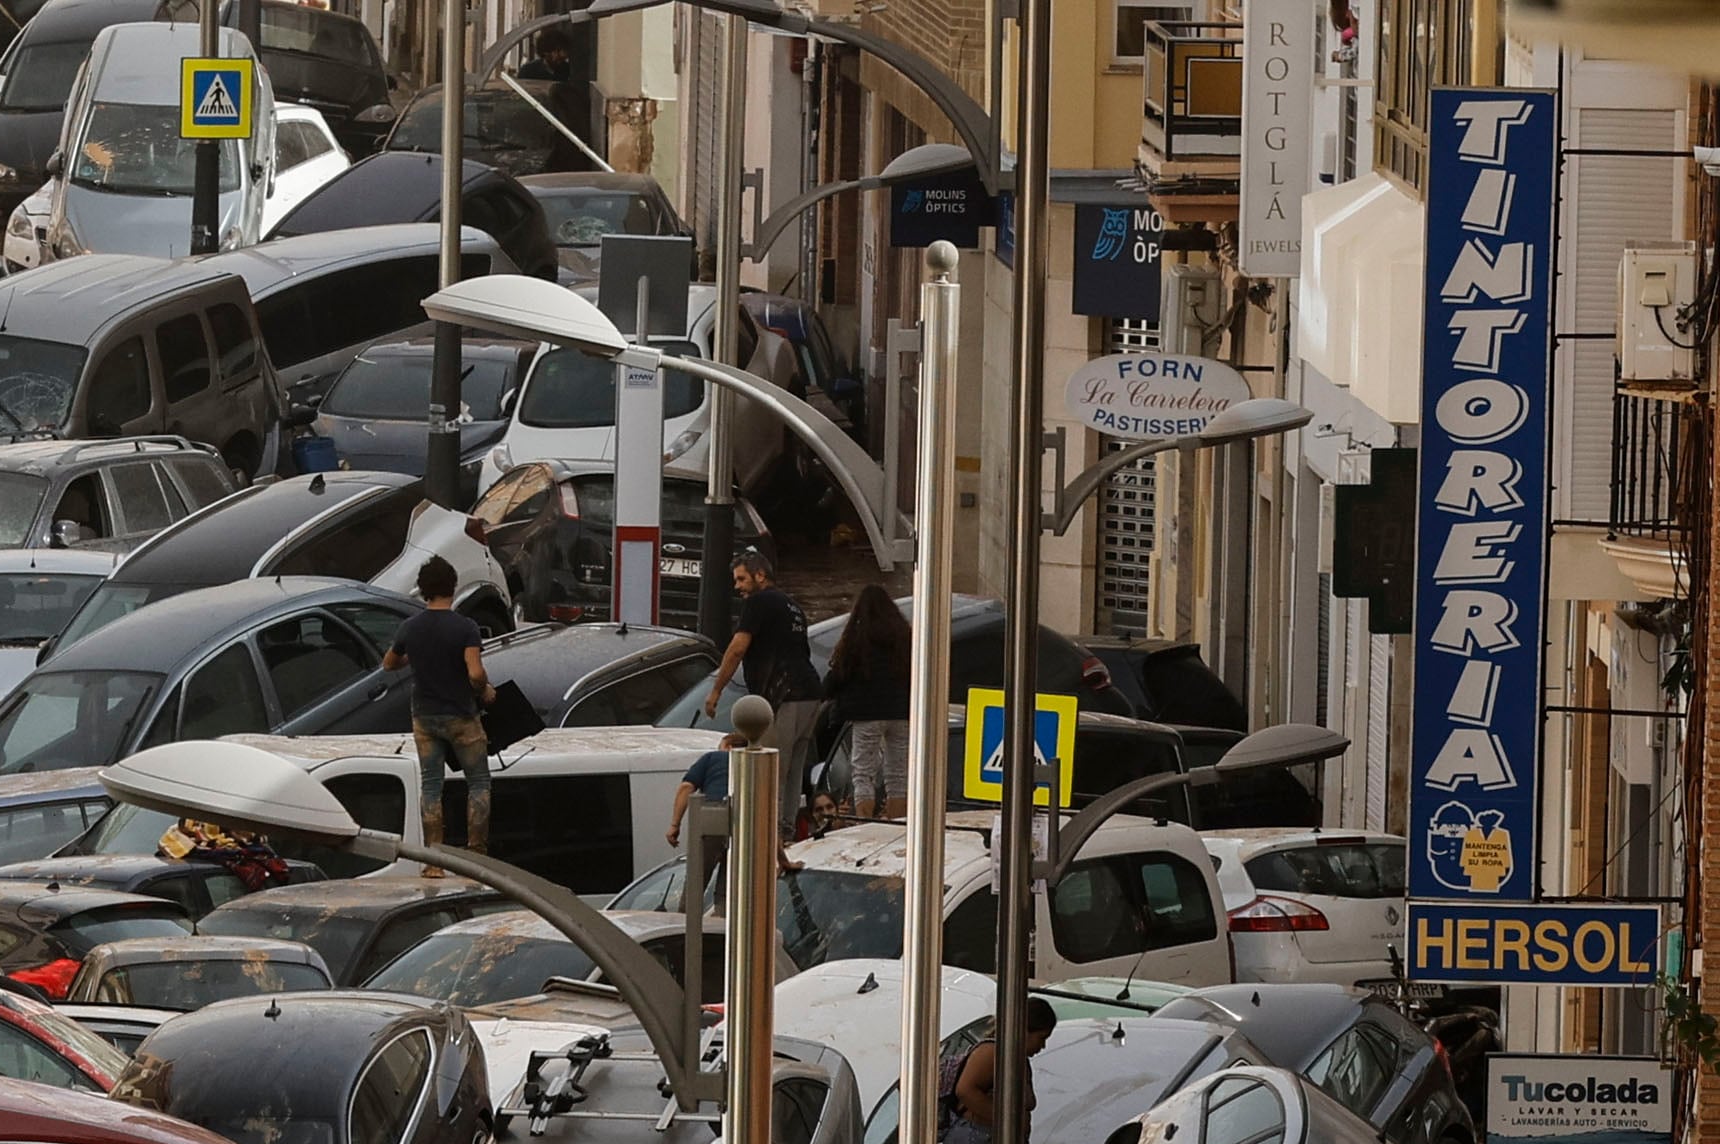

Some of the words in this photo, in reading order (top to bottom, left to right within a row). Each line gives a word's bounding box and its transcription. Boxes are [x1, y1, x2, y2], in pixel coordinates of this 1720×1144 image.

[1265, 23, 1289, 220] ROTGLÁ
[925, 190, 967, 200] MOLINS
[925, 201, 966, 213] ÒPTICS
[1249, 240, 1302, 254] JEWELS
[1118, 359, 1204, 383] FORN
[1080, 377, 1116, 405] La
[1124, 380, 1231, 412] Carretera
[1092, 408, 1216, 435] PASTISSERI
[1424, 99, 1535, 792] TINTORERIA
[1465, 842, 1507, 850] MANTENGA
[1468, 858, 1479, 866] SU
[1416, 918, 1650, 973] HERSOL
[1501, 1075, 1659, 1104] Tucolada
[1519, 1107, 1565, 1115] LAVAR
[1591, 1108, 1638, 1116] SECAR
[1511, 1117, 1571, 1126] LAVANDERÍAS
[1572, 1119, 1597, 1127] AUTO
[1606, 1119, 1648, 1128] SERVICIO
